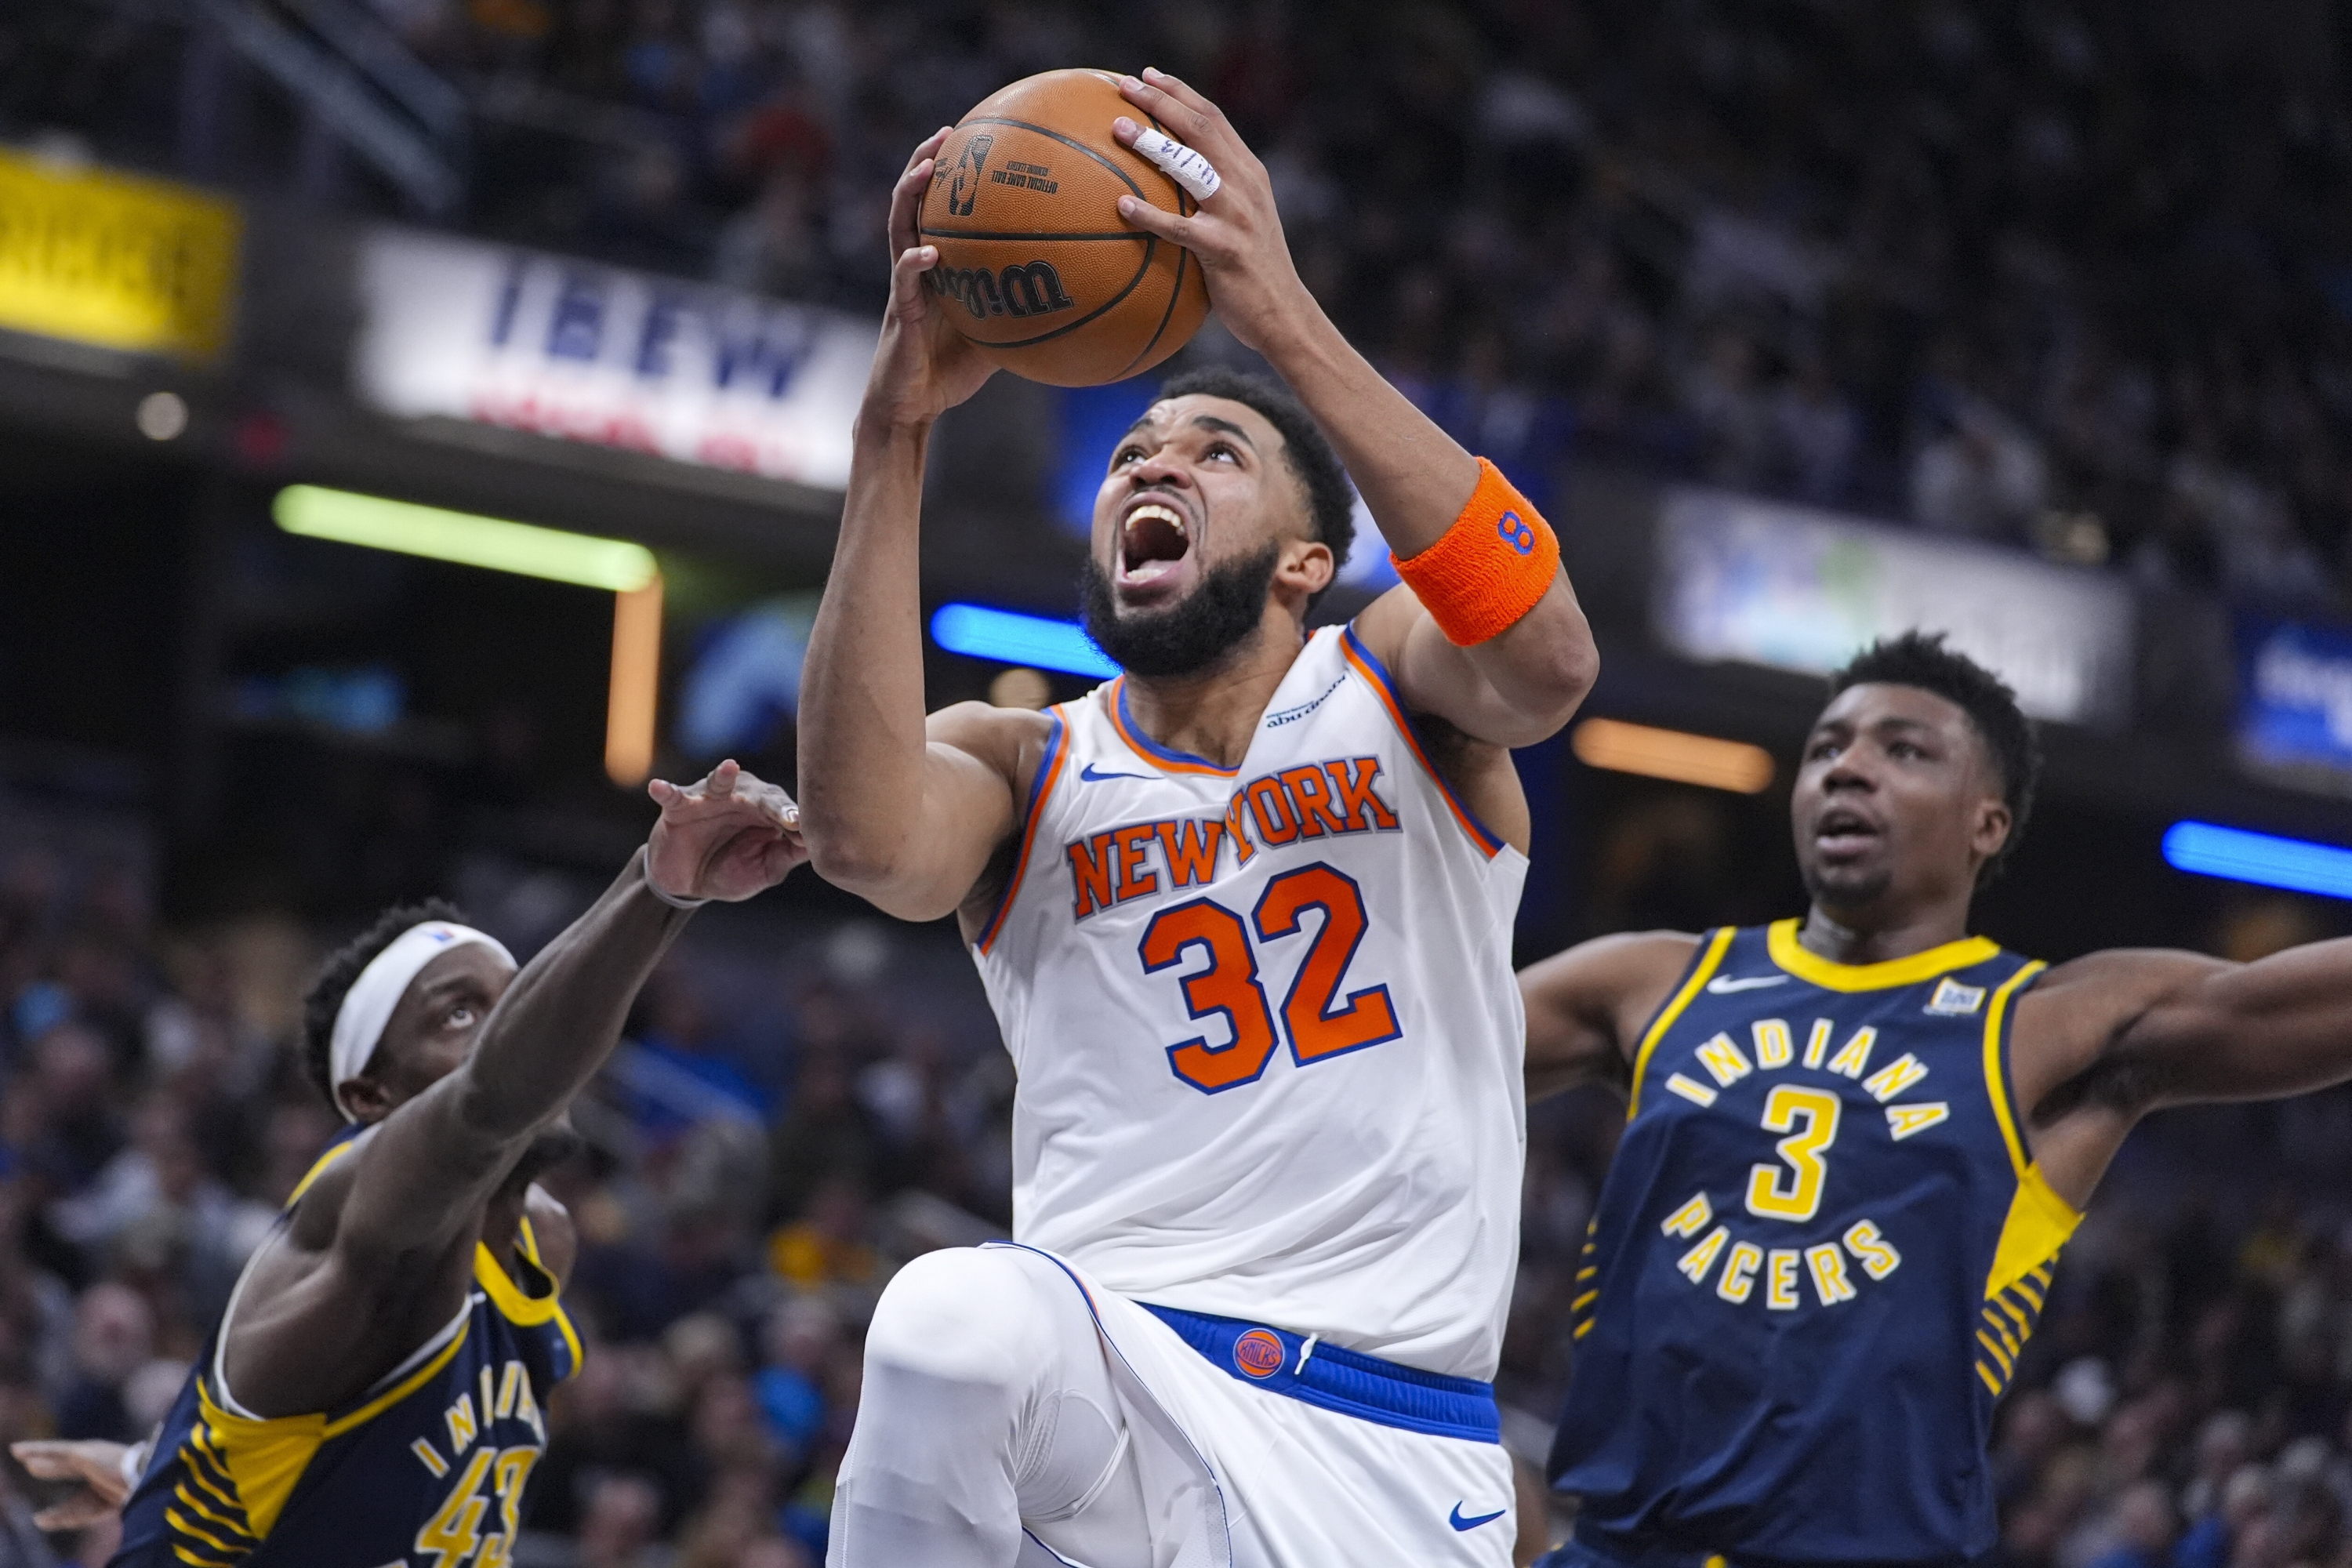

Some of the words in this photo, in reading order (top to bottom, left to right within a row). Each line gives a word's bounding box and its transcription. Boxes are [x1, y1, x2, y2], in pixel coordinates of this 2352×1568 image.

[991, 170, 1007, 184] BALL
[1007, 172, 1026, 187] GAME
[1027, 177, 1058, 194] OFFICIAL
[1497, 510, 1535, 556] 8
[1266, 713, 1302, 728] abu
[1065, 819, 1227, 924] NEW
[1225, 757, 1403, 869] YORK
[1137, 861, 1403, 1095] 32
[1665, 1018, 1949, 1141] INDIANA
[1745, 1083, 1841, 1221] 3
[1661, 1191, 1901, 1310] PACERS
[413, 1446, 541, 1568] 43
